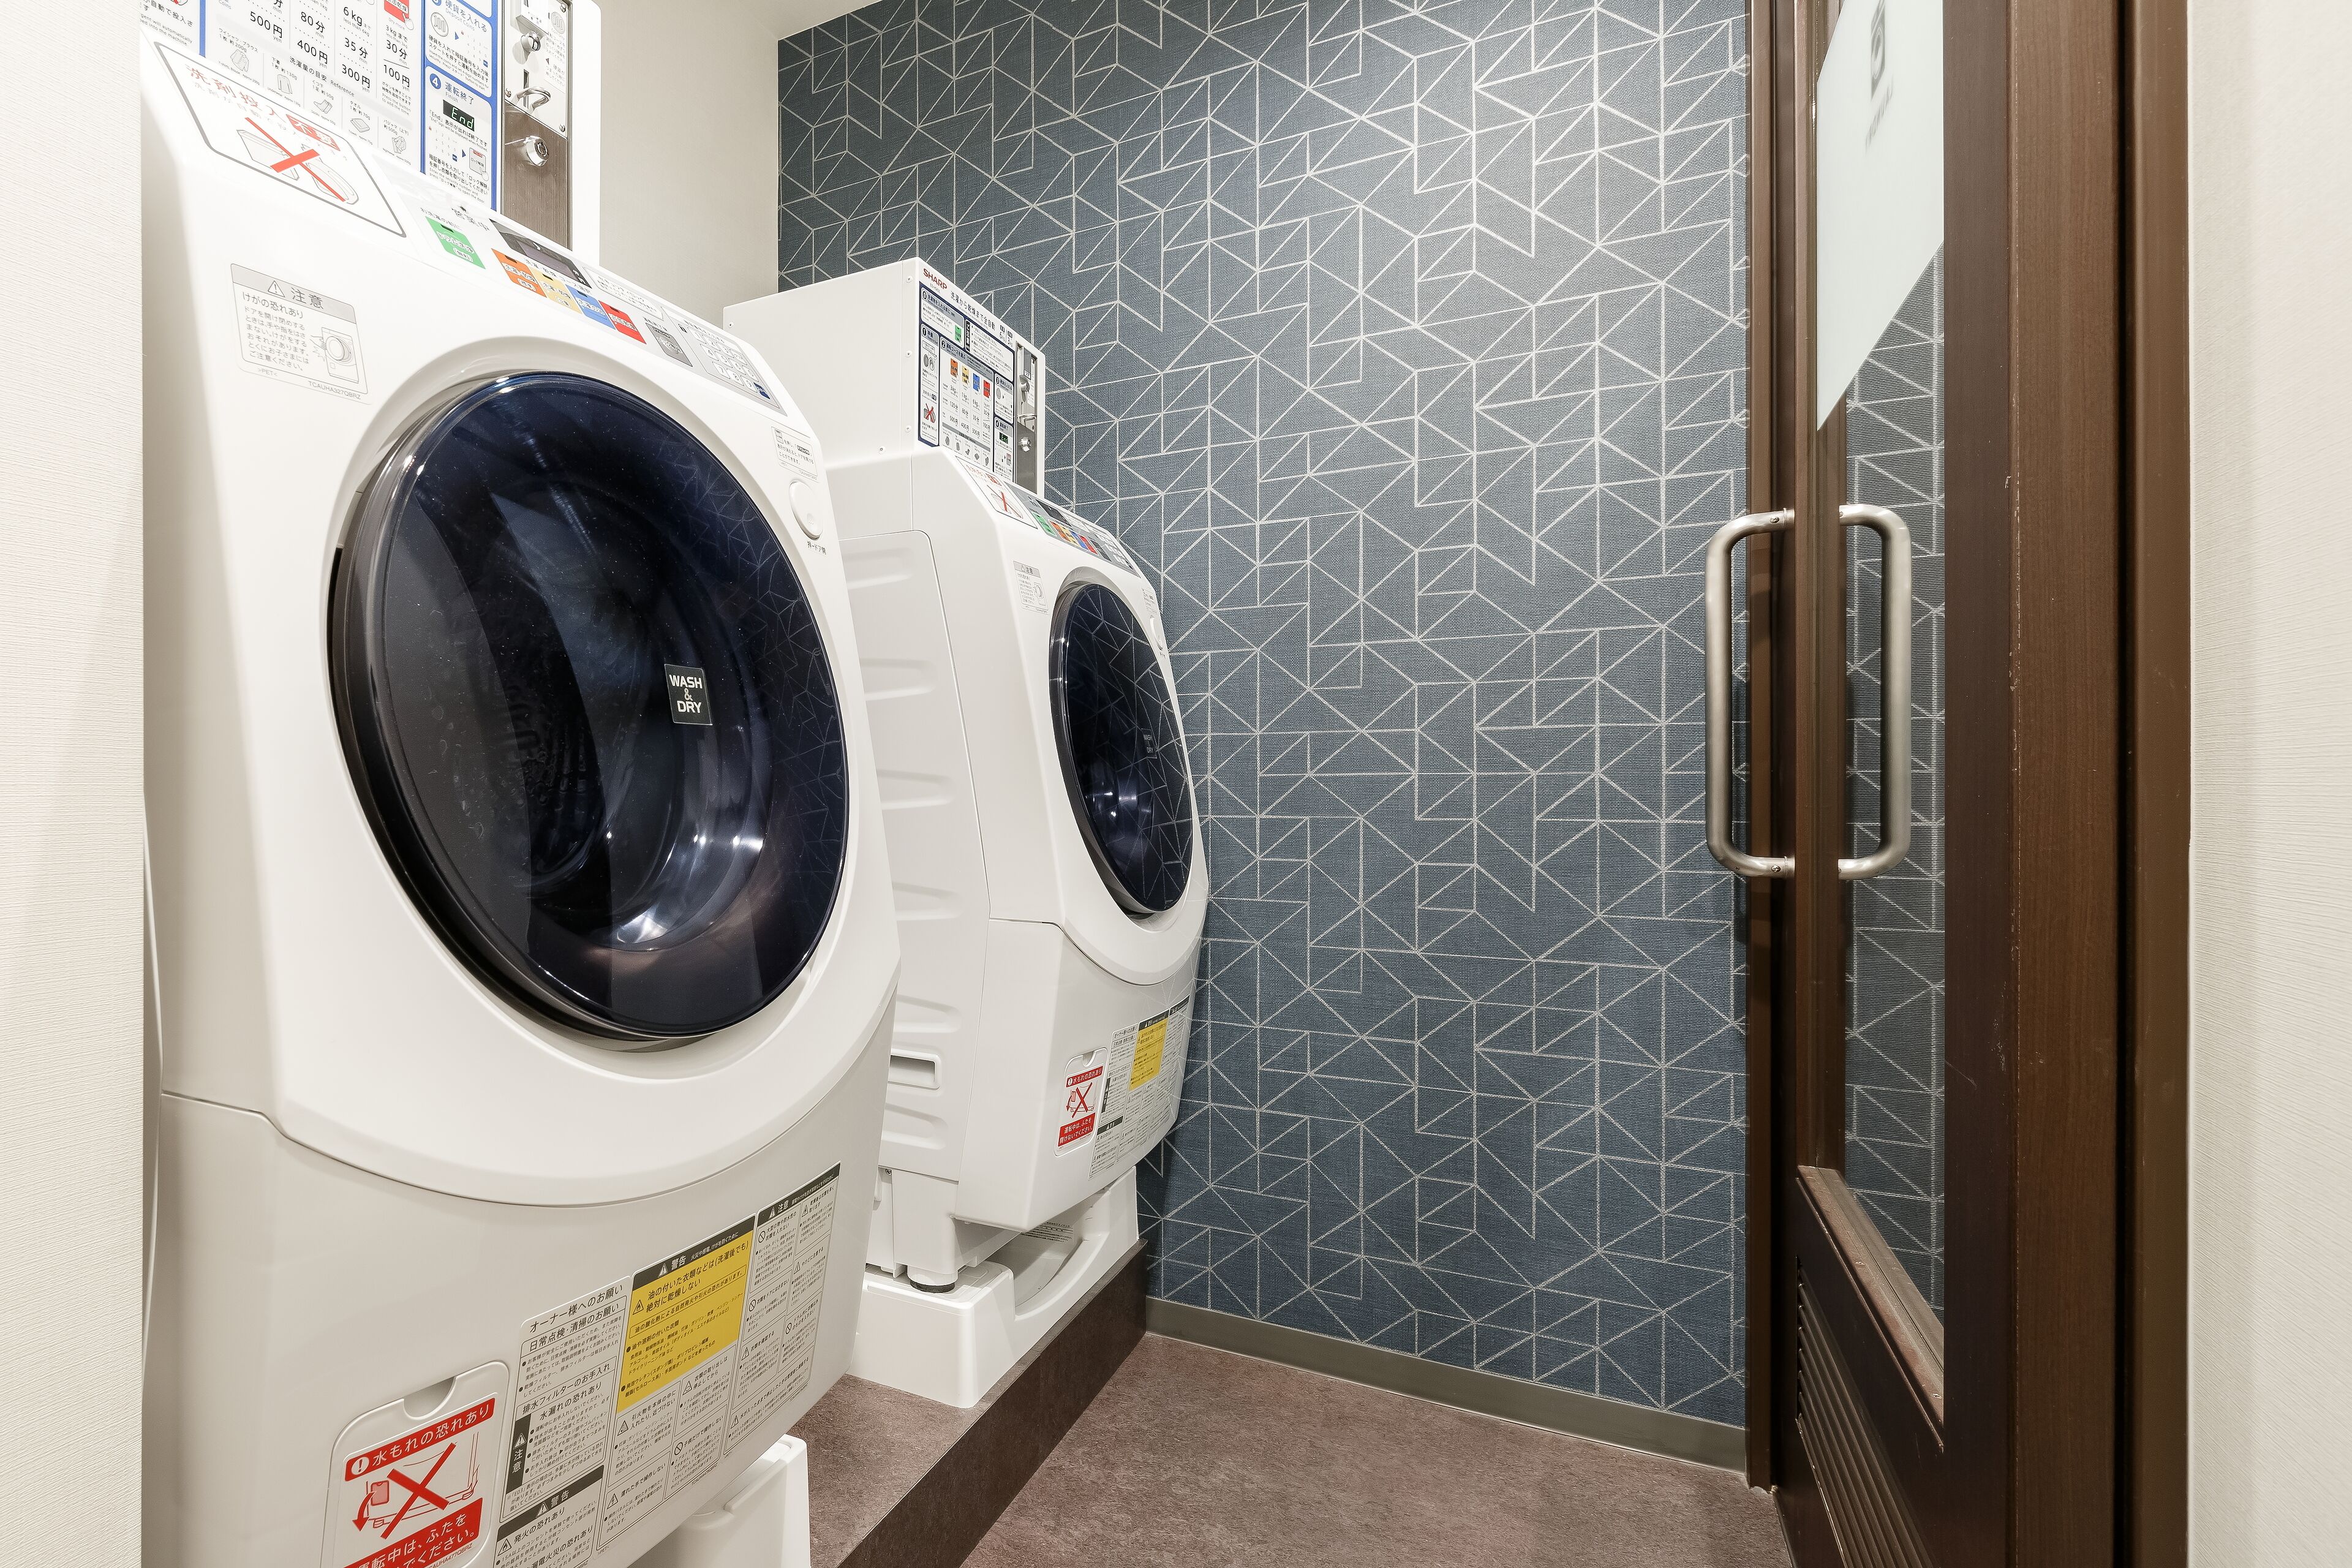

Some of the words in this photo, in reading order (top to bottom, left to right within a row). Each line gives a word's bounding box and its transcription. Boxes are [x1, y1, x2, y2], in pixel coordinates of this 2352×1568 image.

[162, 24, 192, 43] automatically
[250, 11, 282, 38] 500円
[301, 12, 325, 33] 80分
[273, 35, 282, 43] yen
[315, 31, 325, 39] min
[297, 40, 328, 64] 400円
[344, 37, 368, 59] 35分
[386, 40, 407, 59] 30分
[359, 56, 368, 65] min
[289, 56, 327, 83] 洗濯量の目安
[331, 80, 355, 97] Reference
[342, 64, 370, 89] 300円
[383, 64, 410, 88] 100円
[184, 64, 287, 123] 洗剤投入
[445, 81, 473, 105] 運転終了
[445, 91, 458, 103] Finish
[451, 107, 474, 129] End
[923, 268, 948, 290] SHARP
[243, 292, 304, 319] けがの恐れあり
[291, 287, 324, 310] 注意
[244, 306, 306, 331] ドアを開け閉めする
[245, 314, 306, 338] ときは、手や指をはさ
[246, 323, 307, 348] まない。けがをする
[247, 333, 309, 356] おそれがあります。
[249, 341, 309, 364] とくにお子さまには
[249, 350, 304, 371] ご注意ください。
[669, 674, 703, 689] WASH
[684, 687, 693, 701] &
[676, 700, 702, 714] DRY
[1072, 1069, 1102, 1084] 水もれの恐れあり
[1064, 1117, 1092, 1134] 運転中は、ふたを
[777, 1199, 789, 1214] 注意
[647, 1240, 749, 1301] 油の付いた衣類などは(洗濯後でも)
[671, 1255, 686, 1271] 警告
[646, 1278, 701, 1313] 絶対に乾燥しない
[530, 1284, 623, 1333] オーナー様へのお願い
[529, 1303, 619, 1352] 日常点検・清掃のお願い
[522, 1363, 610, 1415] 排水フィルターのお手入れ
[540, 1381, 602, 1421] 水漏れの恐れあり
[630, 1398, 676, 1430] 入れたり、近づけない
[631, 1389, 676, 1421] 引火物を本体の中に
[372, 1403, 489, 1466] 水もれの恐れあり
[512, 1449, 524, 1474] 注意
[620, 1463, 666, 1498] 濡れた手で操作しない
[551, 1490, 570, 1508] 警告
[514, 1507, 565, 1545] 発火の恐れあり
